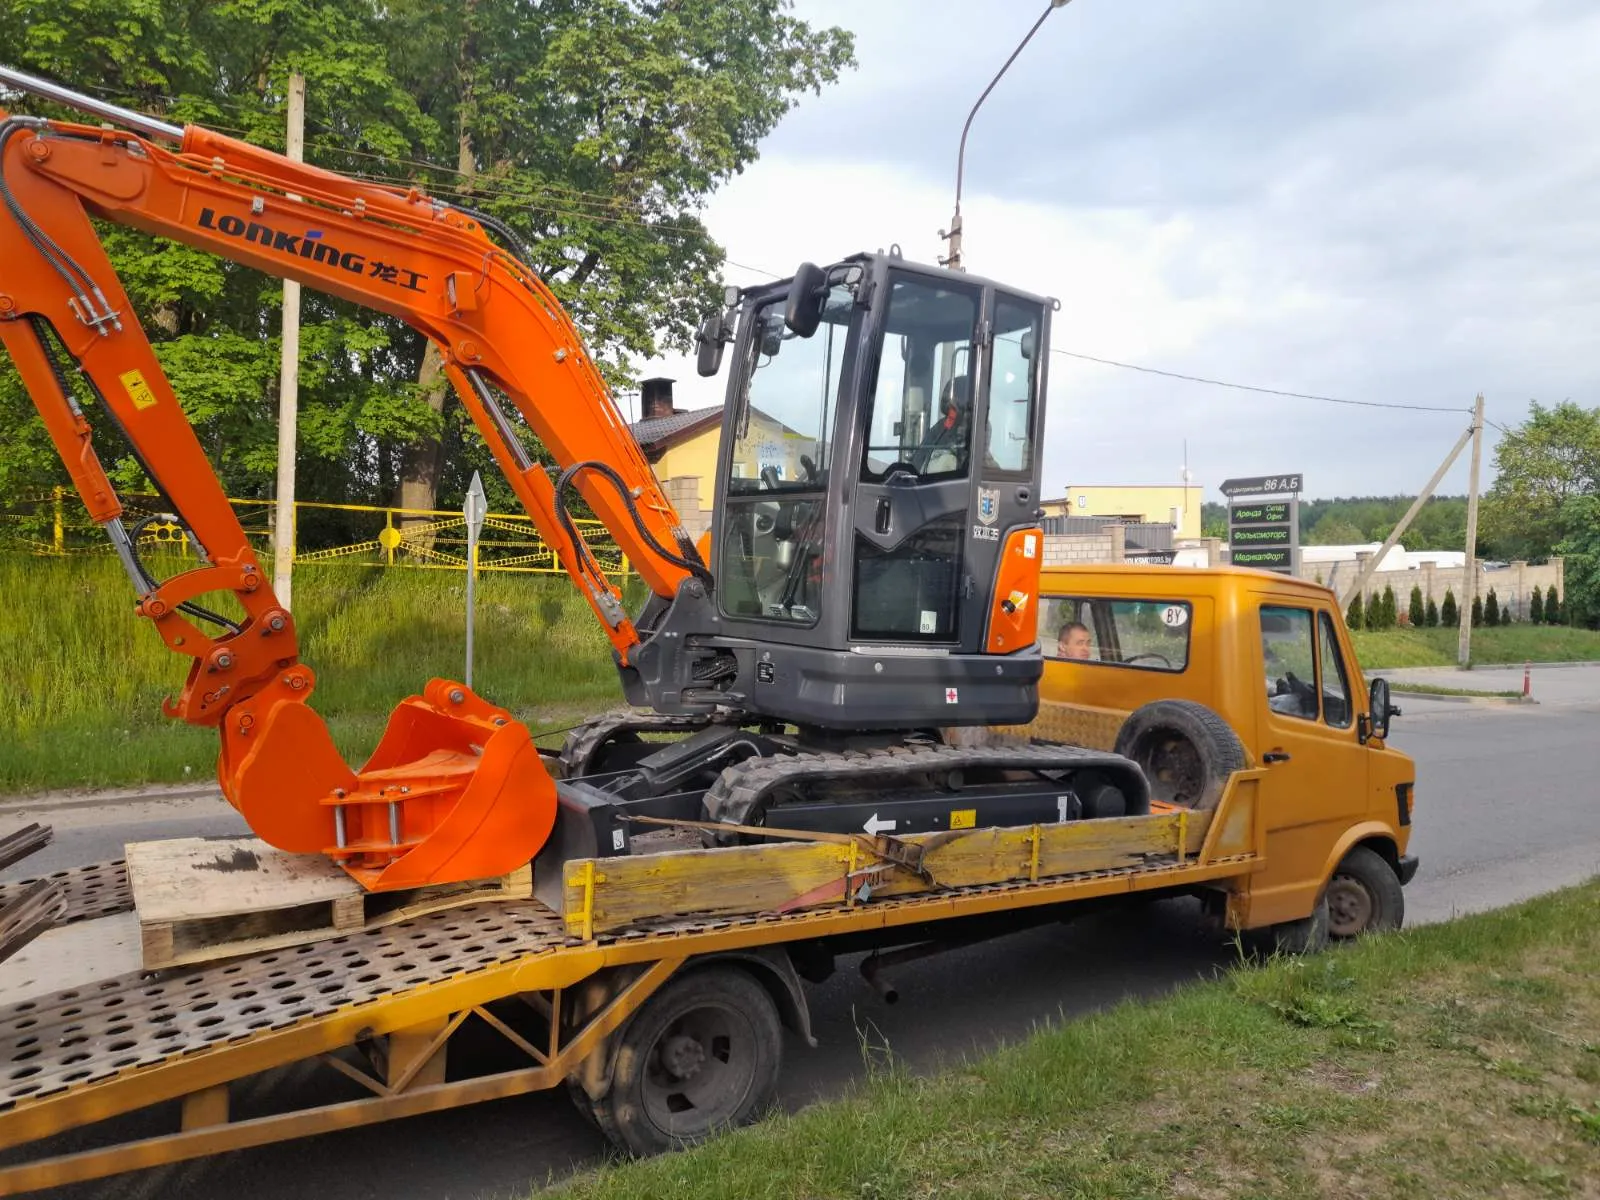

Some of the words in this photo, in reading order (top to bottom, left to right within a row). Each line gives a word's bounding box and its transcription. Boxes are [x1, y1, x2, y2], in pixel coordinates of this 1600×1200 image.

[369, 261, 428, 293] 龙工
[1264, 479, 1277, 491] 86
[1236, 510, 1261, 518] Аренда
[1234, 531, 1287, 539] Фольксмоторс
[1167, 608, 1181, 623] BY
